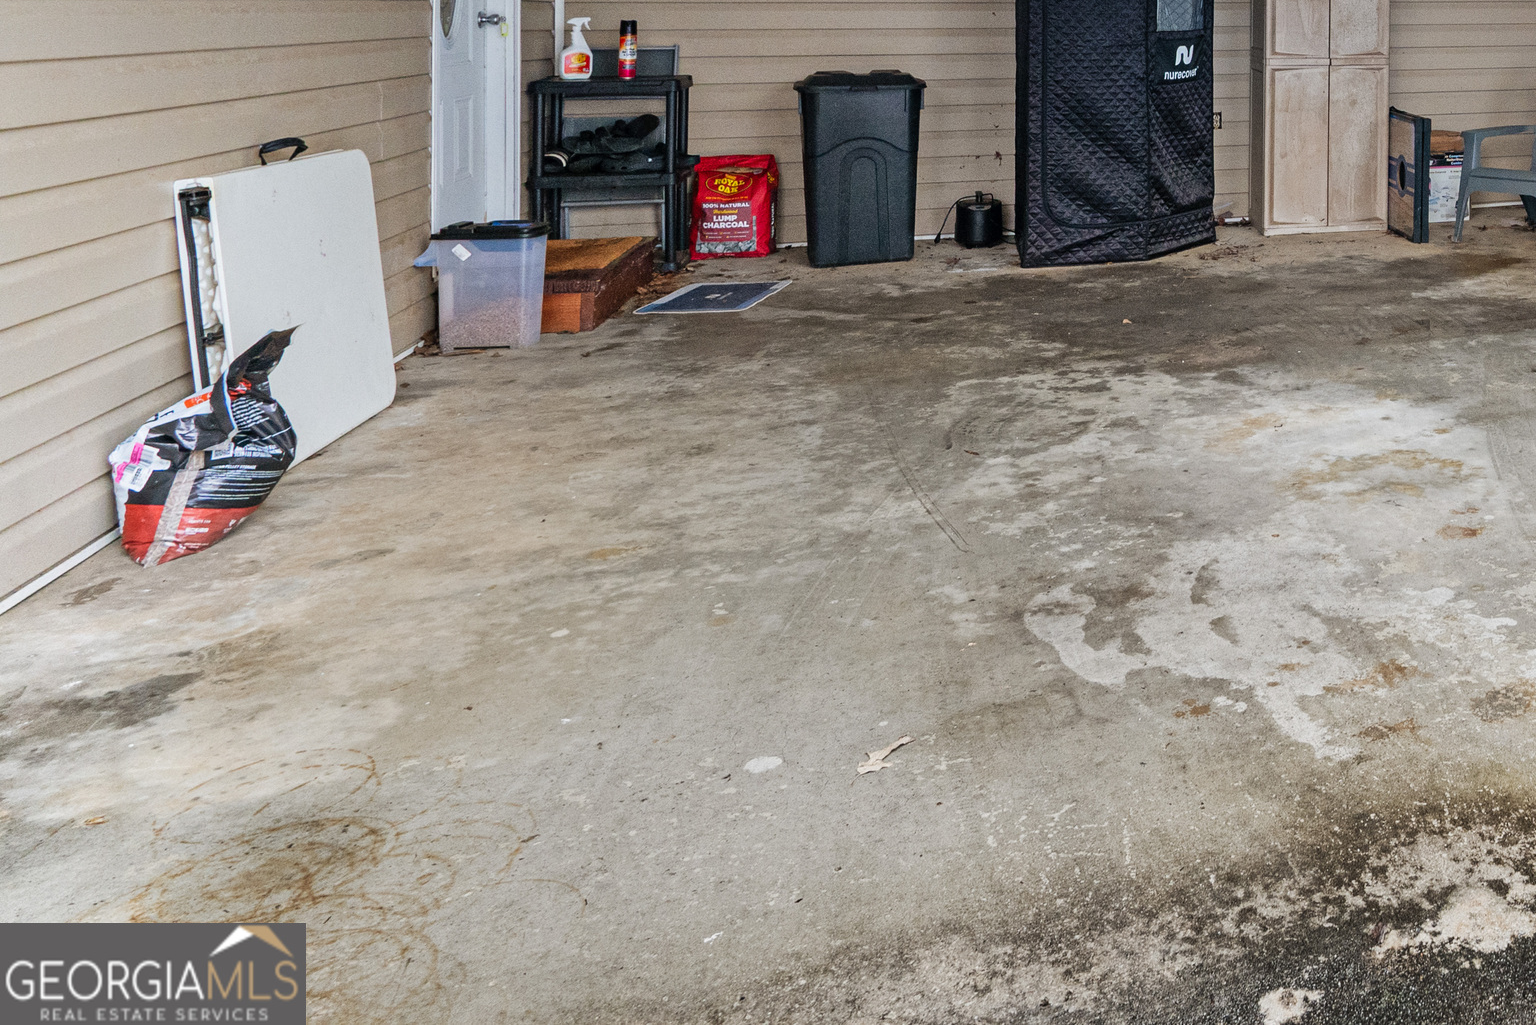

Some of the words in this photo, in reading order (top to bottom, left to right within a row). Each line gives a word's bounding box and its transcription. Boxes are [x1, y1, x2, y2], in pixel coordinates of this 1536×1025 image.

[1164, 68, 1197, 80] nurecover
[714, 178, 745, 186] ROYAL
[718, 185, 738, 193] OAK
